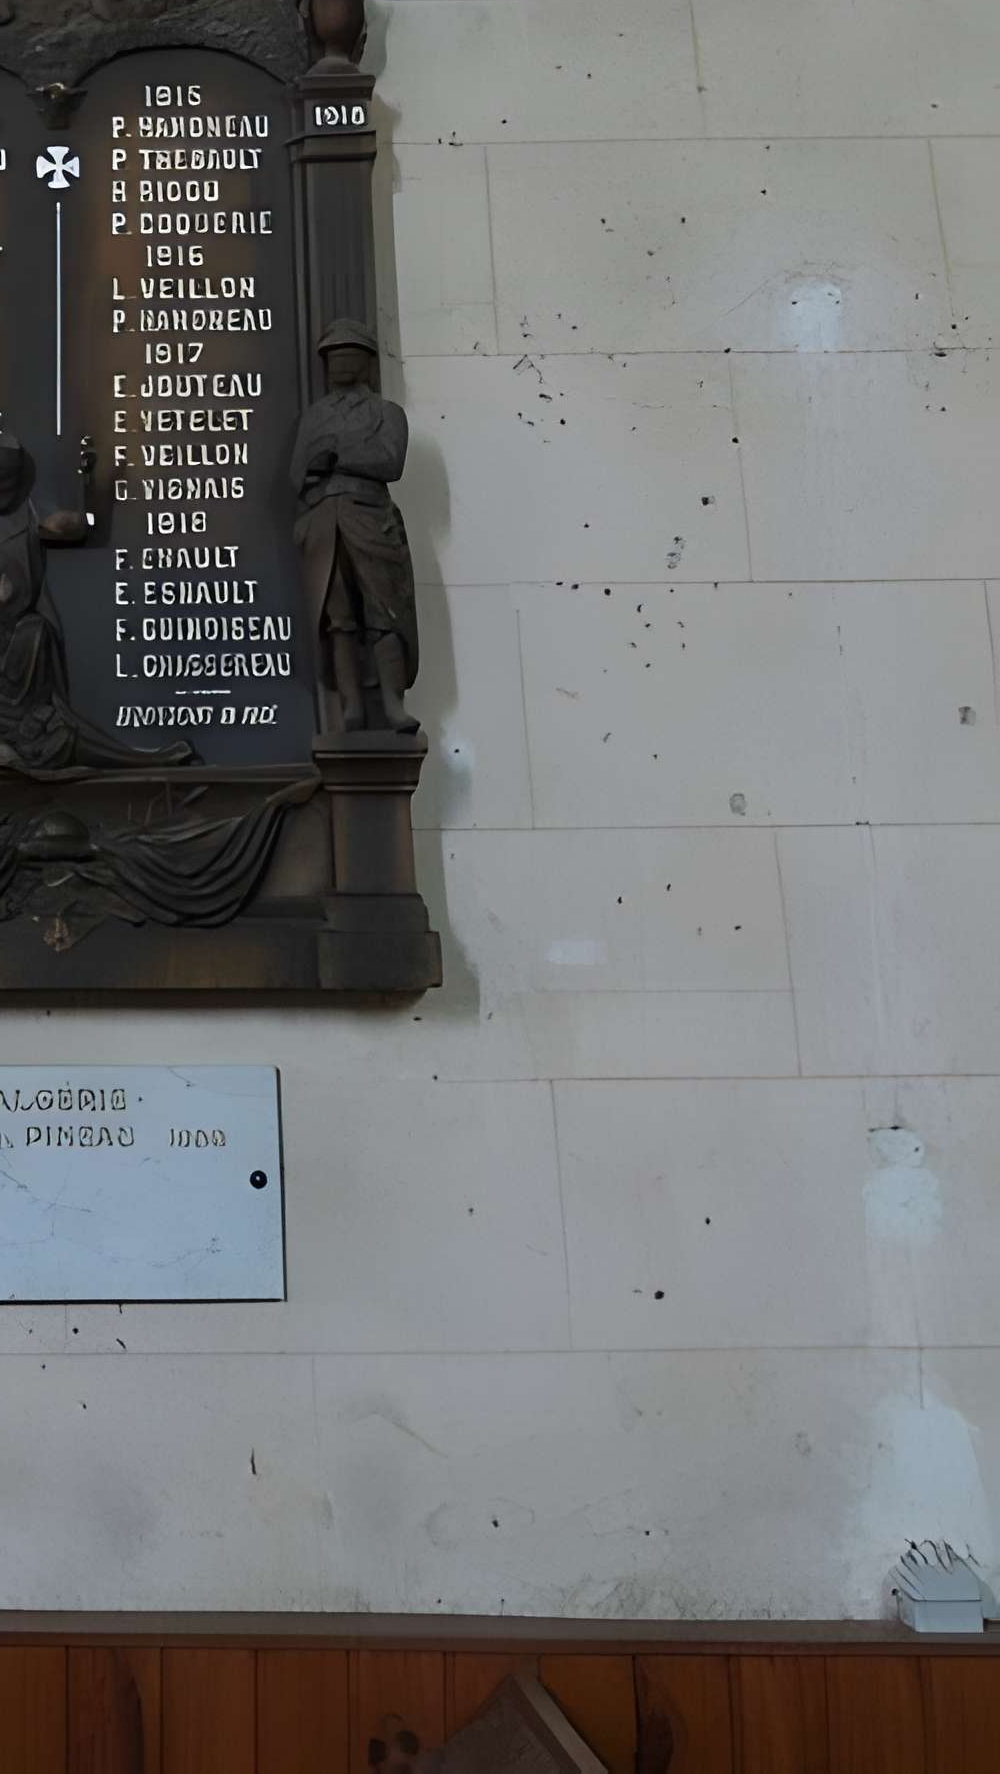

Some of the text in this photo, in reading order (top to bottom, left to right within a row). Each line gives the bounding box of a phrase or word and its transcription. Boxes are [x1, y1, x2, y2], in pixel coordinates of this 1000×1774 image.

[140, 276, 255, 300] VEILLON
[145, 342, 204, 365] 1917
[140, 443, 248, 467] VEILLON
[115, 580, 136, 605] E.
[115, 616, 136, 641] F.
